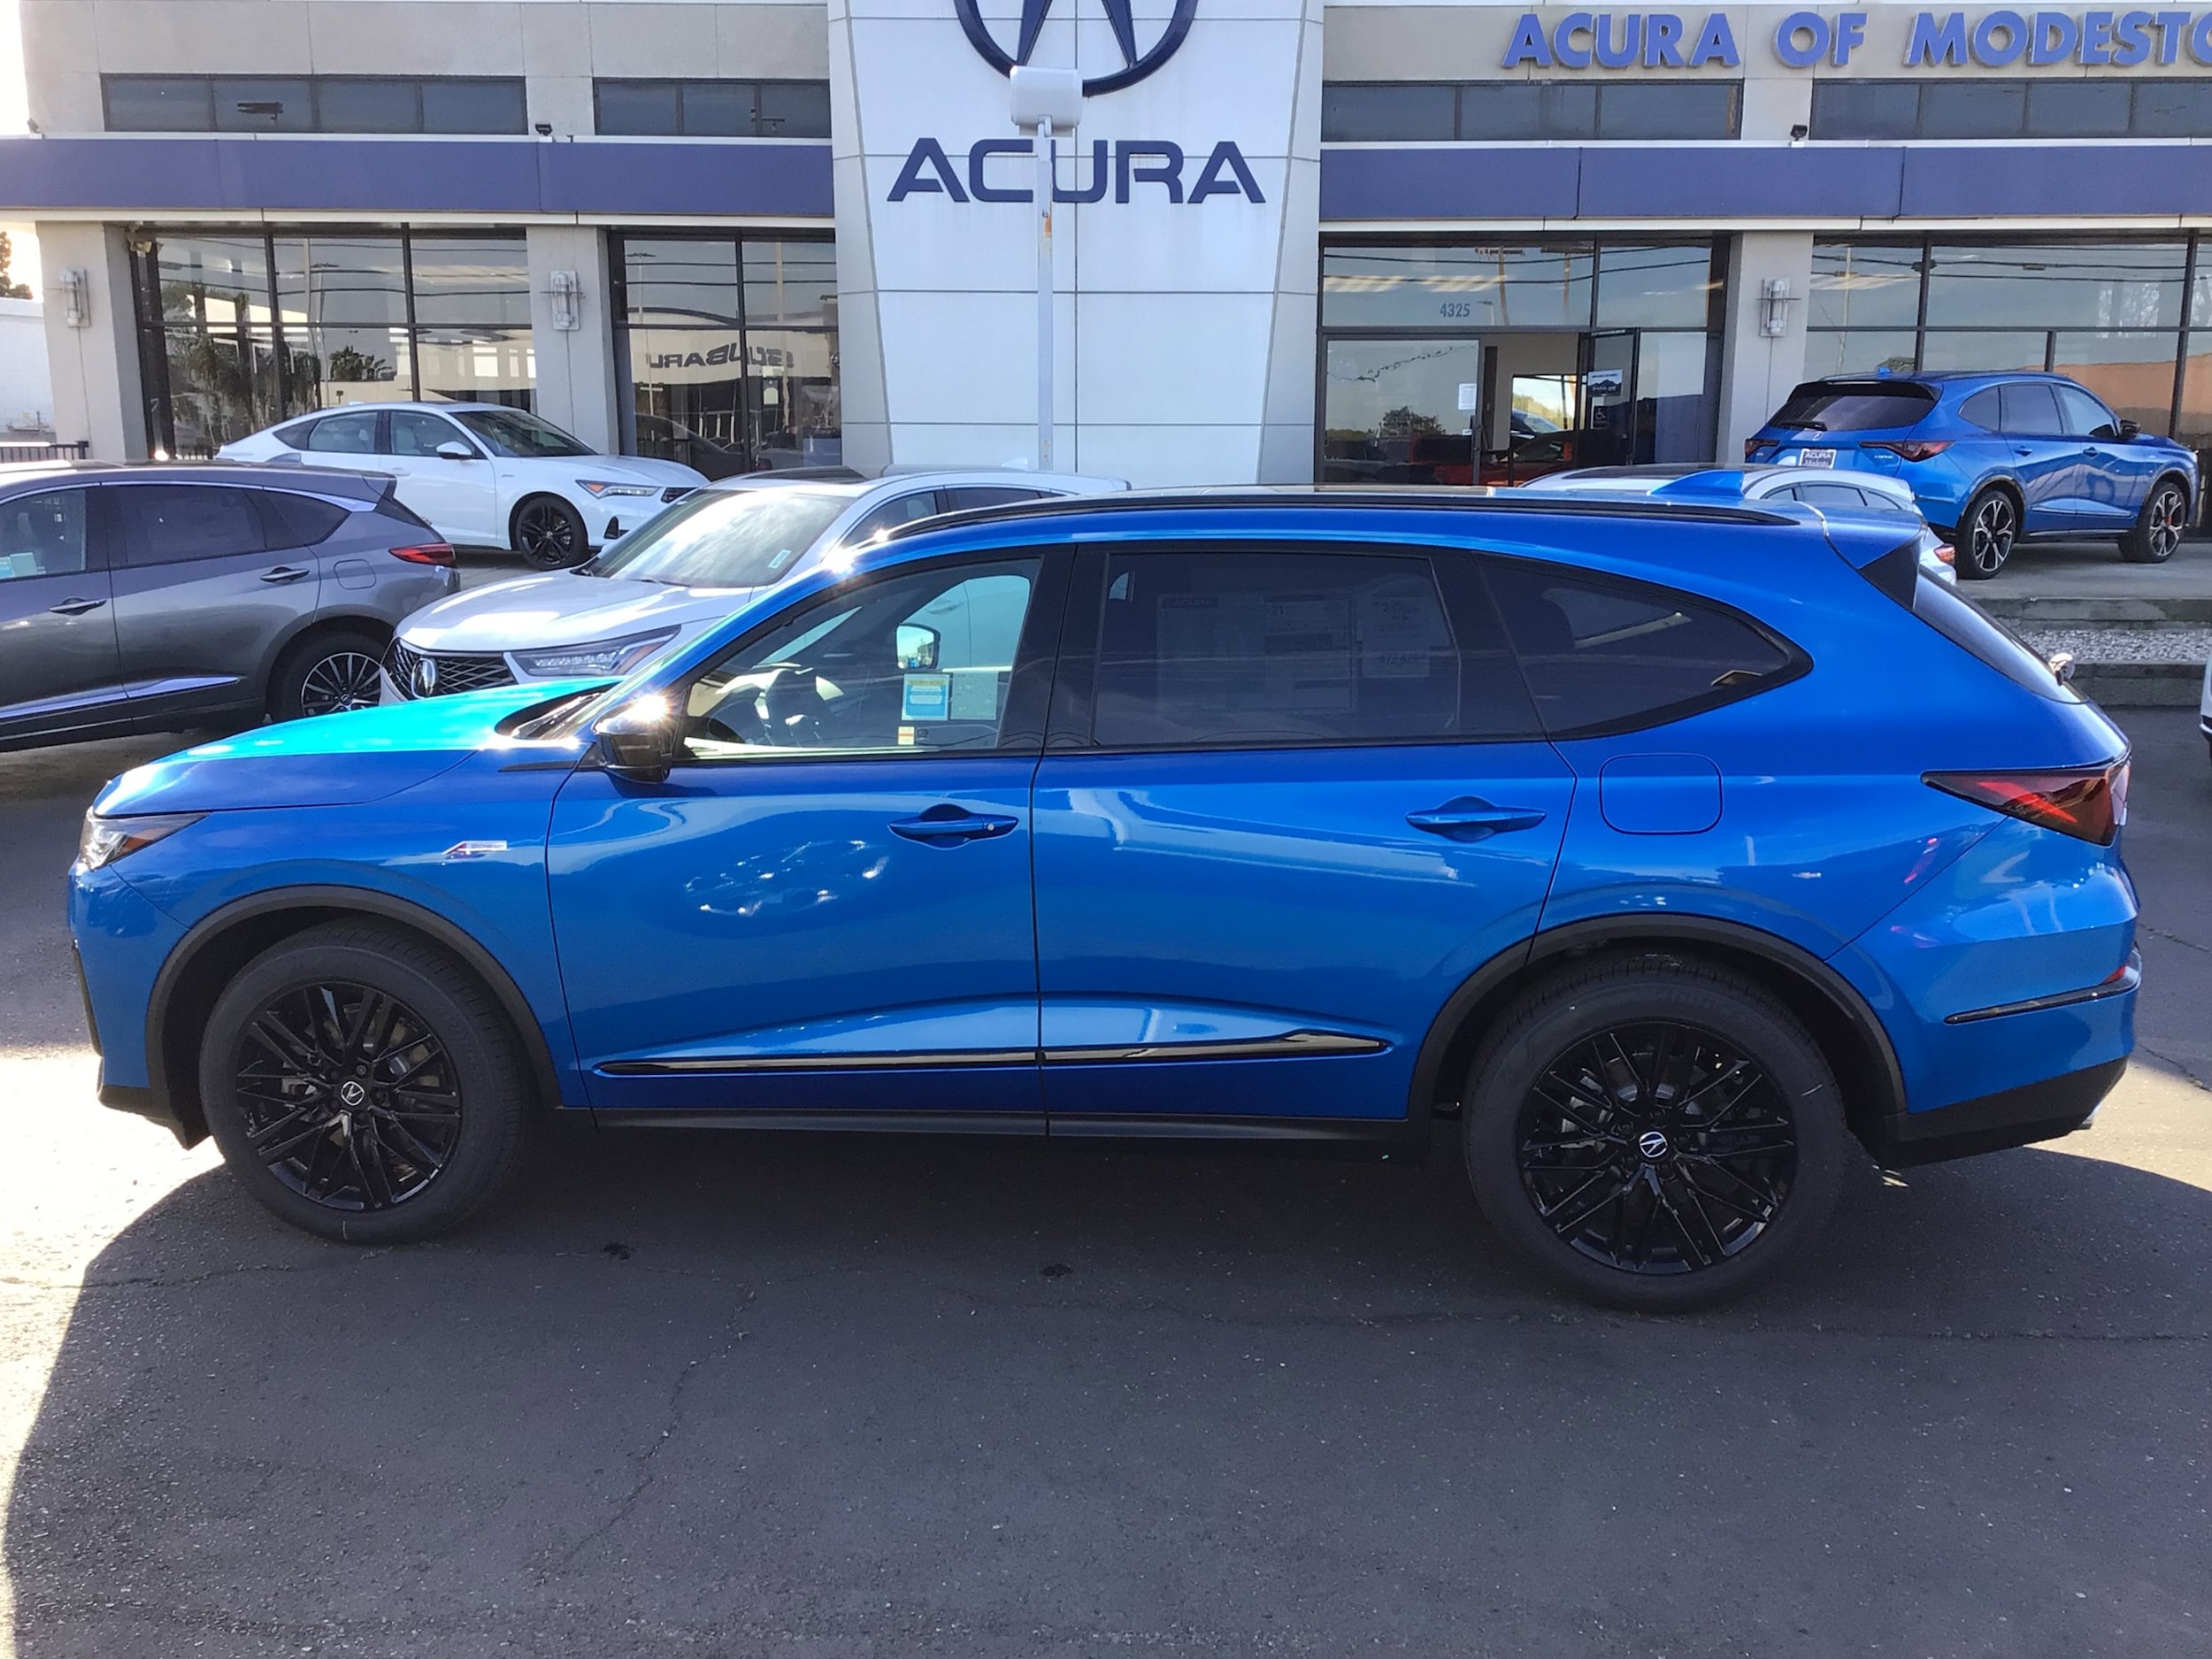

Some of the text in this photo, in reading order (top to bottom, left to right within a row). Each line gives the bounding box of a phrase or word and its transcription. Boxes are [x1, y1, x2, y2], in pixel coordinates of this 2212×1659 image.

[1502, 12, 1742, 68] ACURA
[1772, 11, 1869, 68] OF
[887, 137, 1266, 204] ACURA
[1440, 303, 1471, 318] 4325
